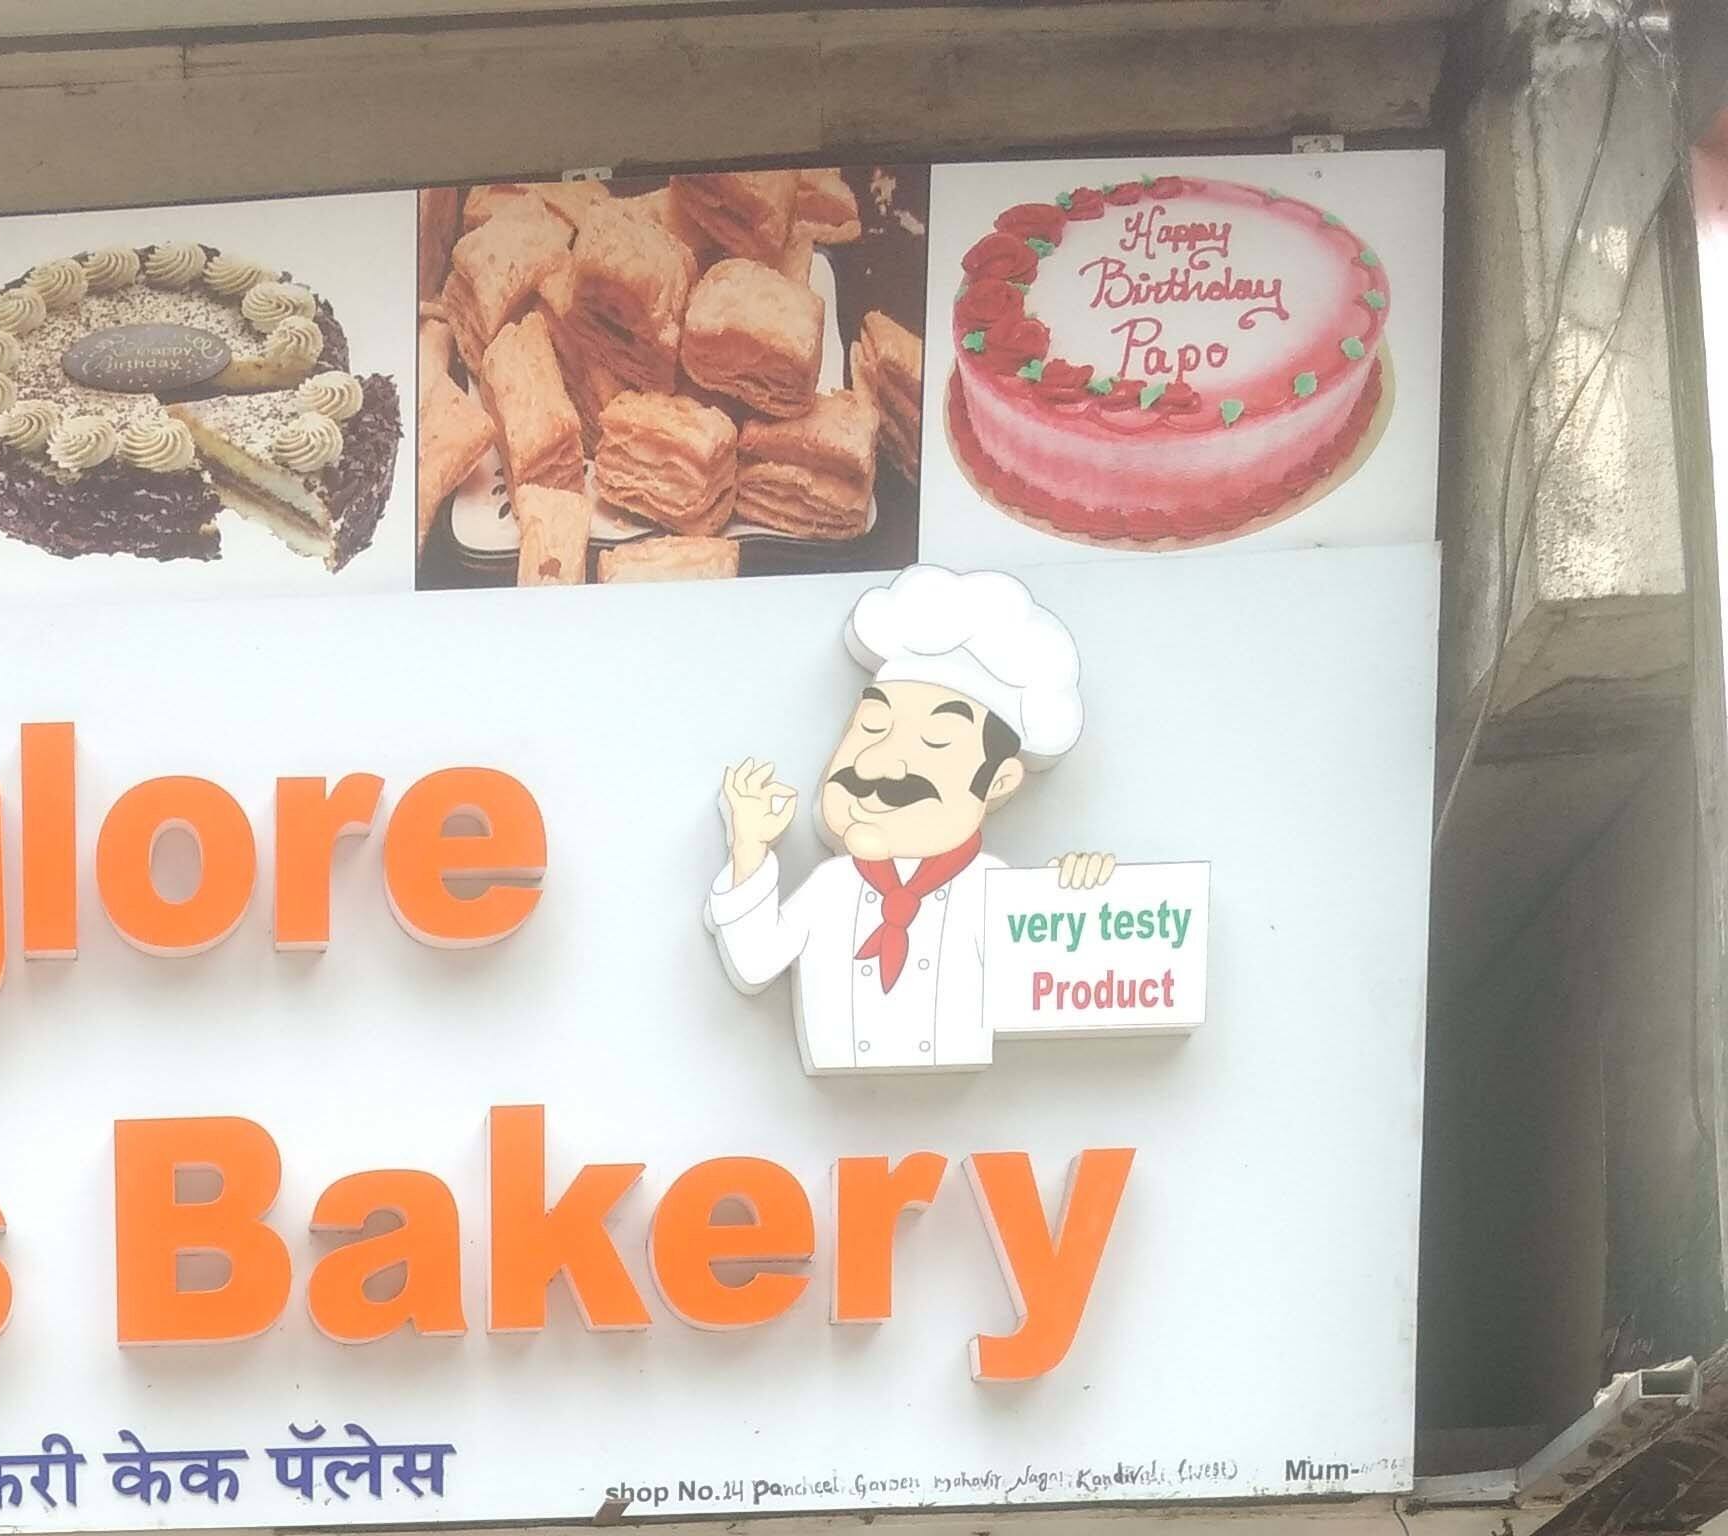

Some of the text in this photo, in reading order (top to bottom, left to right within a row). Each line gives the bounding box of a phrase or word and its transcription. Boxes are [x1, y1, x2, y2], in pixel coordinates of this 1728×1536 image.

[1120, 205, 1233, 271] Happy
[1079, 255, 1290, 330] Birthday
[1110, 317, 1229, 384] Papo
[1007, 899, 1192, 953] very testy
[1032, 968, 1175, 1011] Product
[113, 1104, 1134, 1381] Bakery
[103, 1429, 250, 1505] केक
[265, 1420, 456, 1500] पॅलेस
